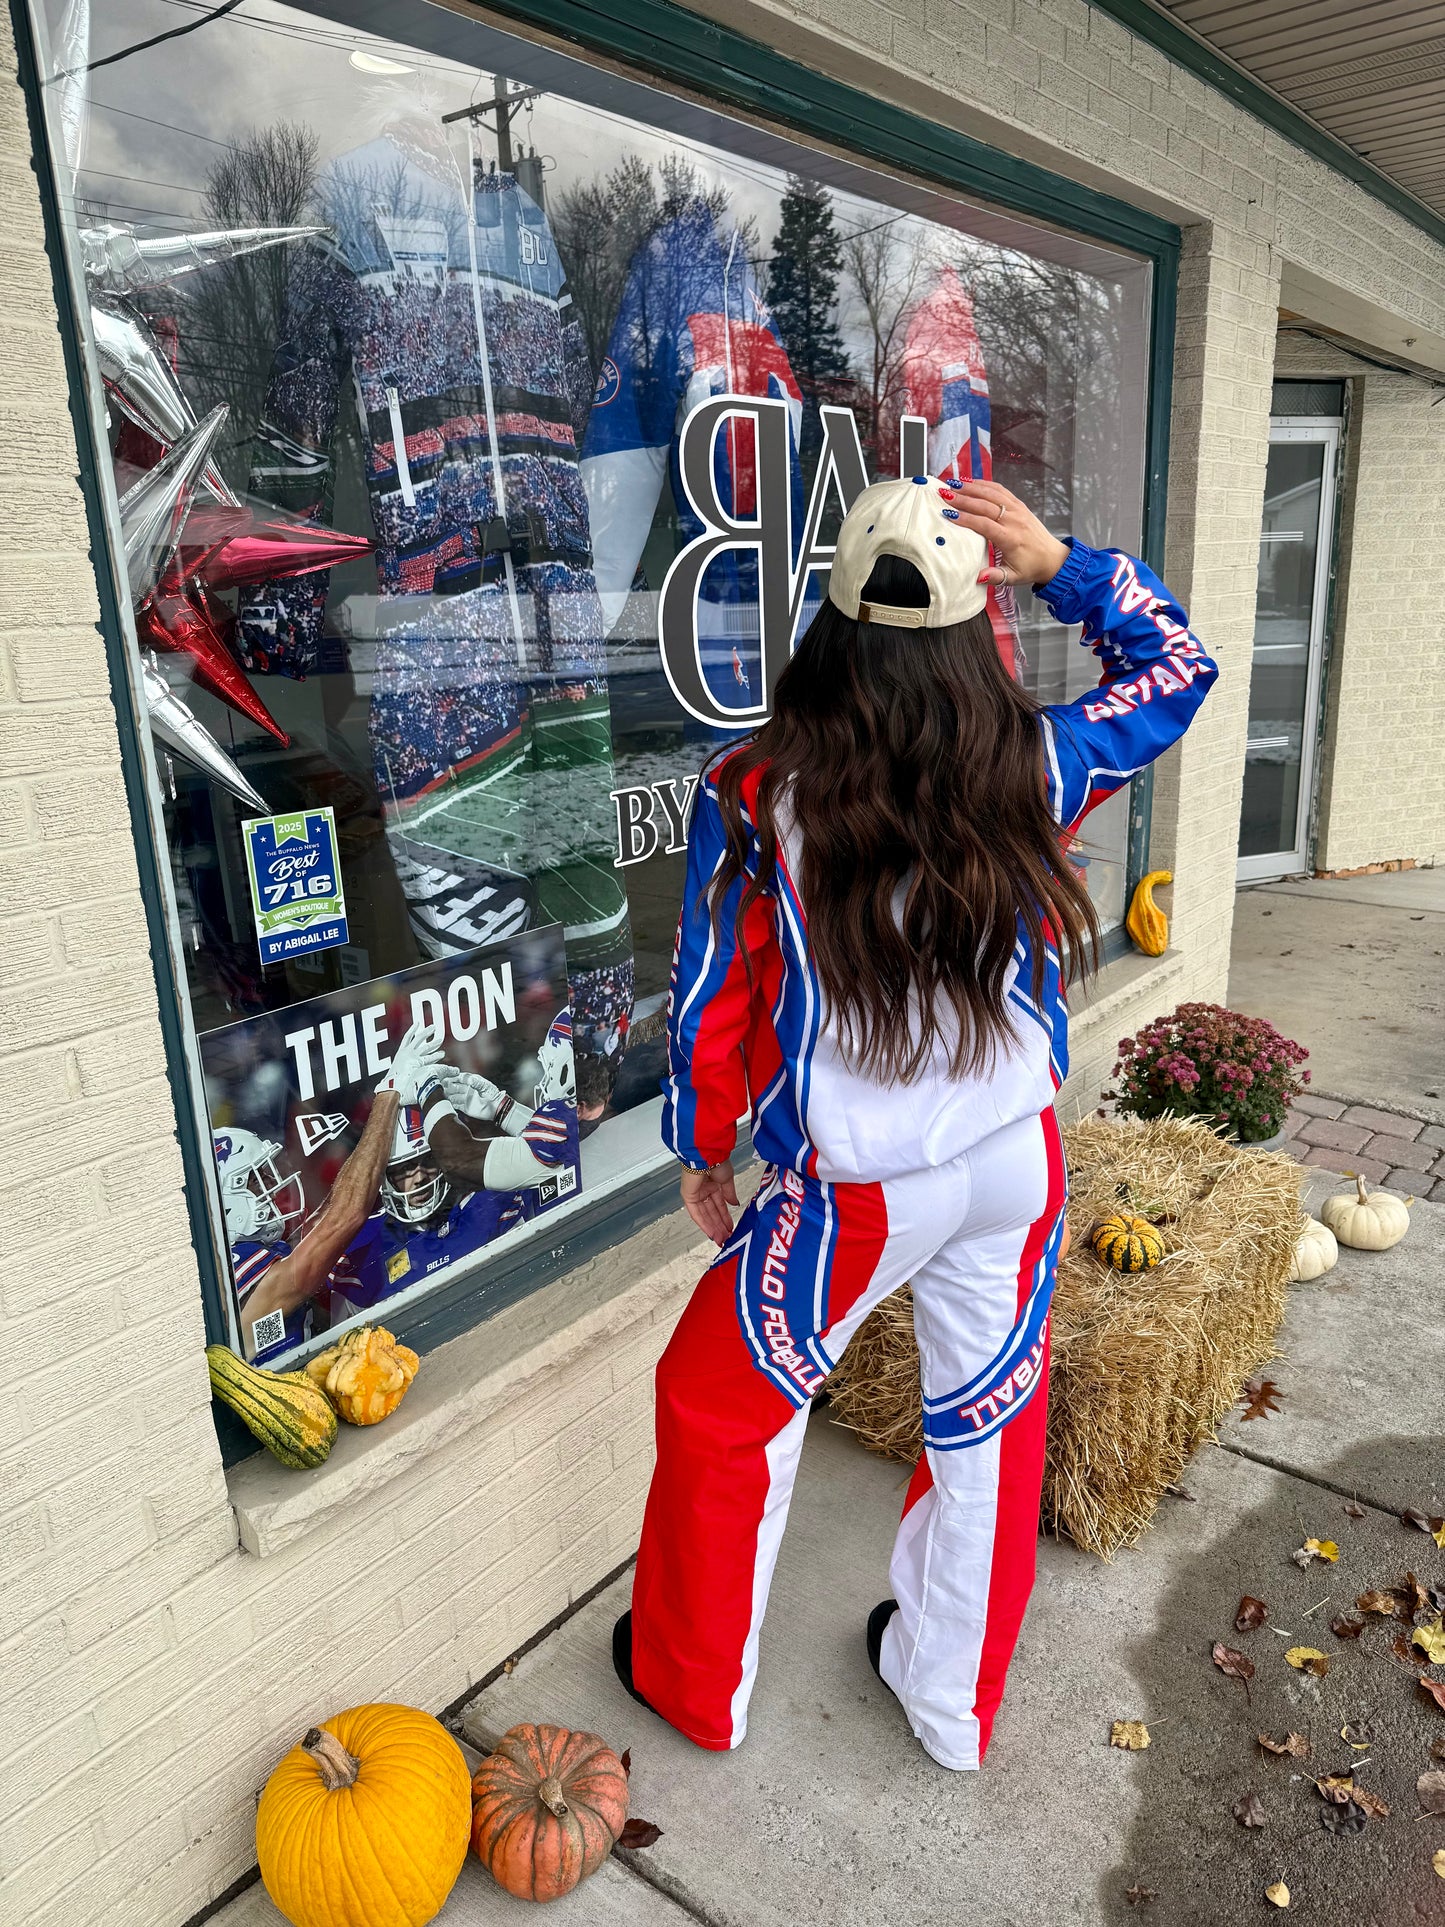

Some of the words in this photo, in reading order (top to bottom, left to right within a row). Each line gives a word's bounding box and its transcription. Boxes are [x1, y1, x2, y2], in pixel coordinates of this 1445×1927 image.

[278, 822, 302, 834] 2025
[609, 774, 700, 869] BY
[278, 846, 303, 855] BUFFALO
[268, 850, 320, 882] Best
[295, 870, 307, 878] OF
[263, 874, 332, 905] 716
[272, 906, 300, 922] WOMEN'S
[300, 901, 329, 915] BOUTIQUE
[269, 941, 283, 954] BY
[284, 931, 322, 951] ABIGAIL
[323, 928, 340, 940] LEE
[284, 1002, 392, 1102] THE
[410, 961, 517, 1051] DON
[426, 1254, 450, 1273] BILLS
